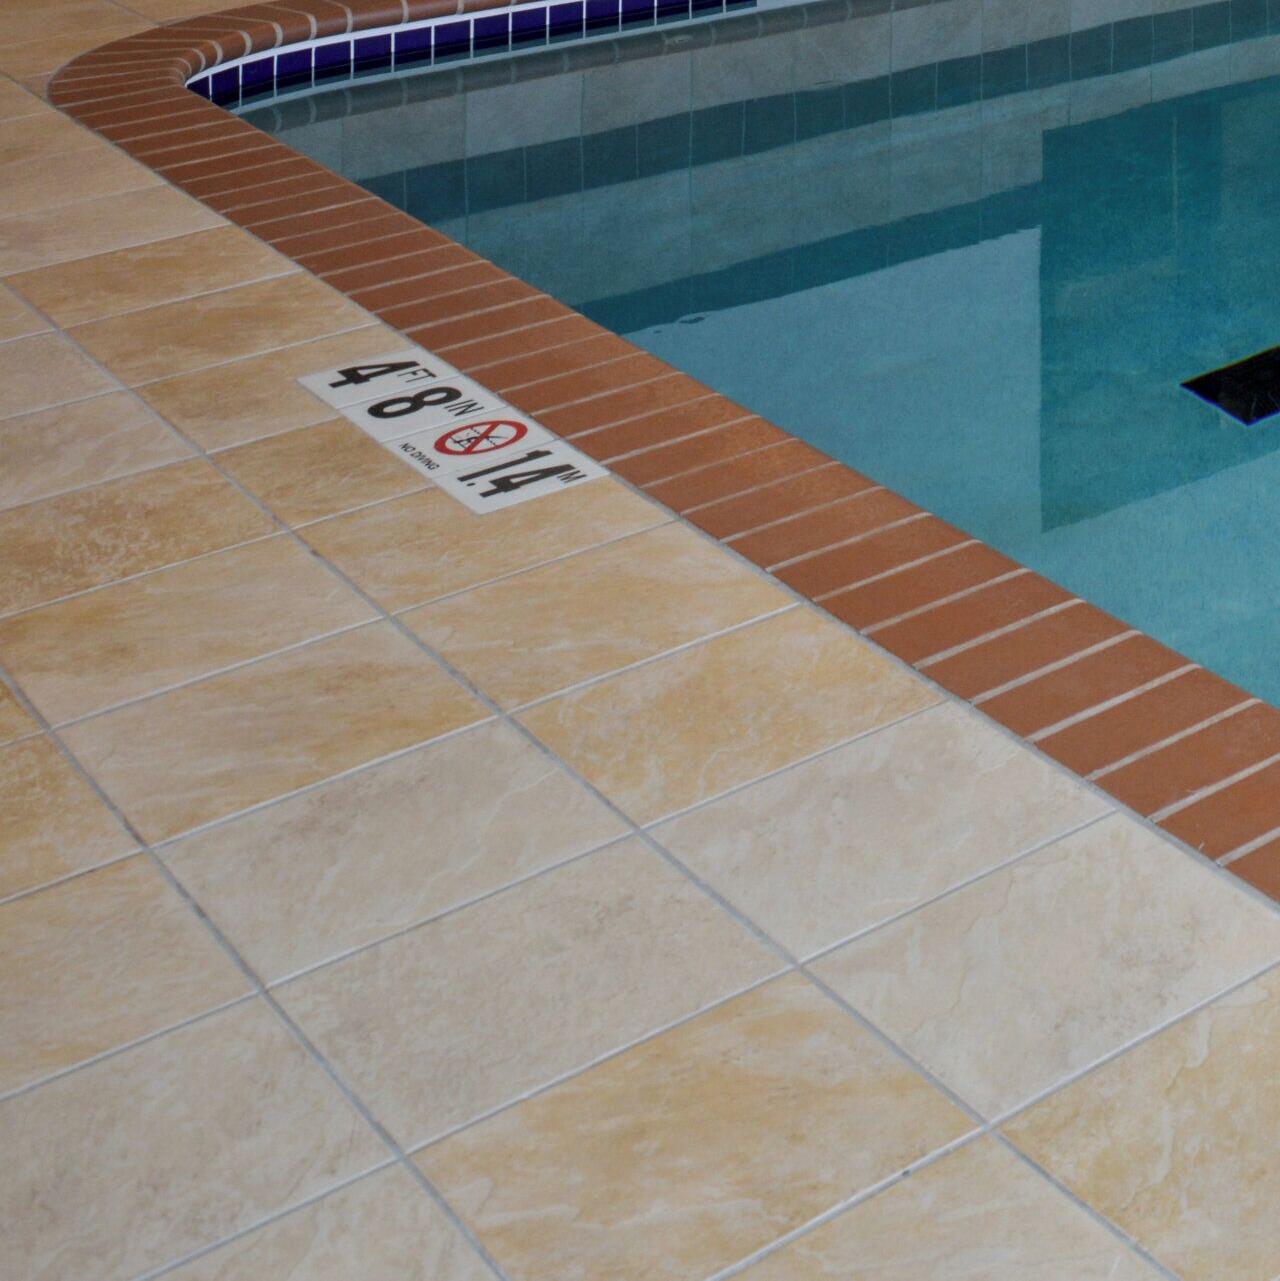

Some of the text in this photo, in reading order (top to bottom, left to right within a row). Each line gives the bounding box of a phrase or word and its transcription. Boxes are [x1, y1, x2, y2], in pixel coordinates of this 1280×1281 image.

[328, 361, 587, 498] 4 FT 8 IN 1.4 M
[399, 442, 440, 471] NO DIVING
